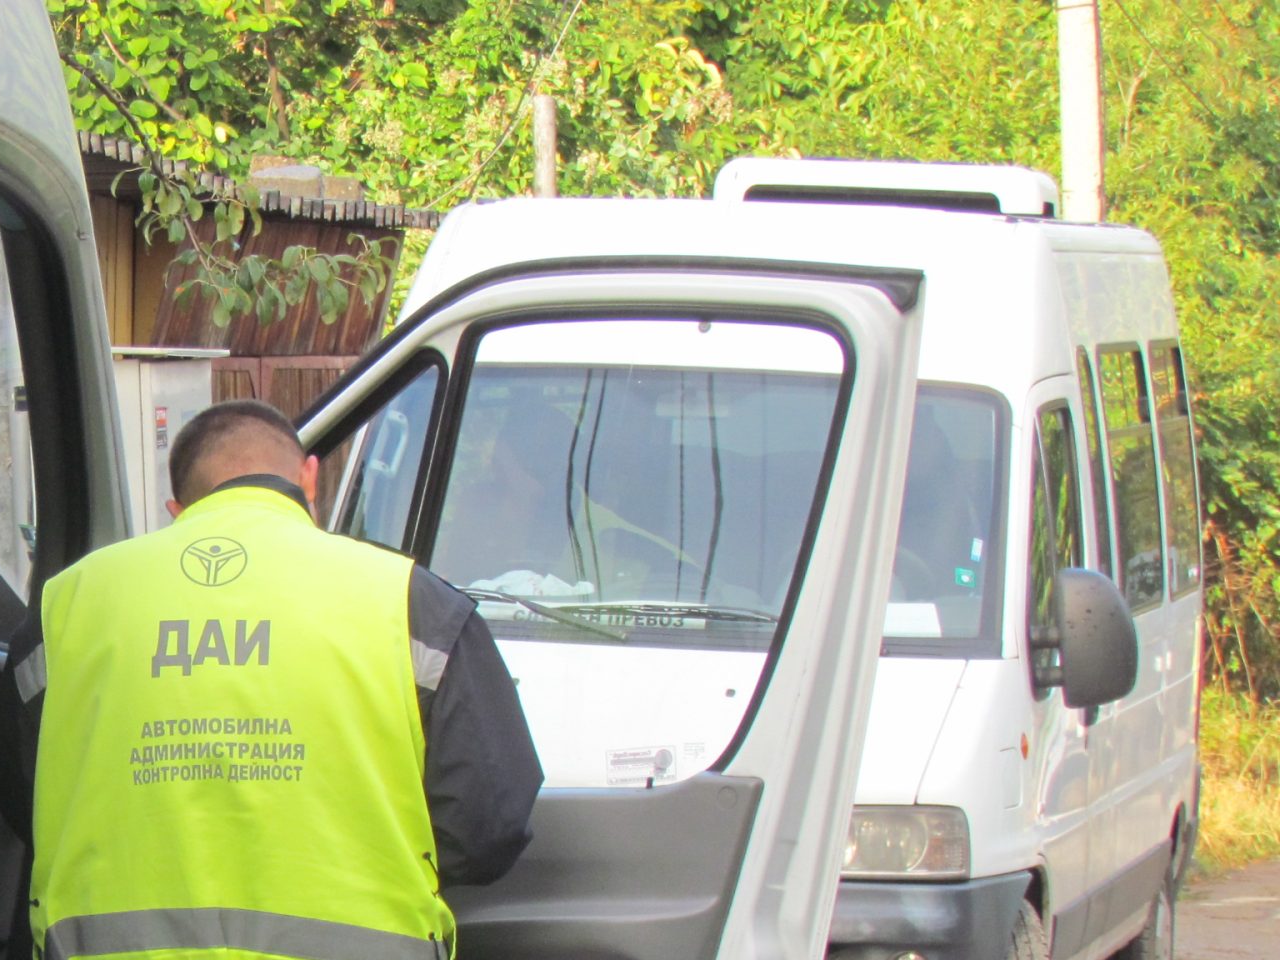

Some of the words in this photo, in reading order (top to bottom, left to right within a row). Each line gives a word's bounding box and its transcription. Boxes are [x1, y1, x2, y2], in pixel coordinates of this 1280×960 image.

[151, 619, 271, 678] ДАИ
[141, 718, 292, 739] АВТОМОБИЛНА
[129, 742, 305, 765] АДМИНИСТРАЦИЯ
[133, 763, 224, 786] КОНТРОЛНА
[228, 762, 303, 783] ДЕЙНОСТ
